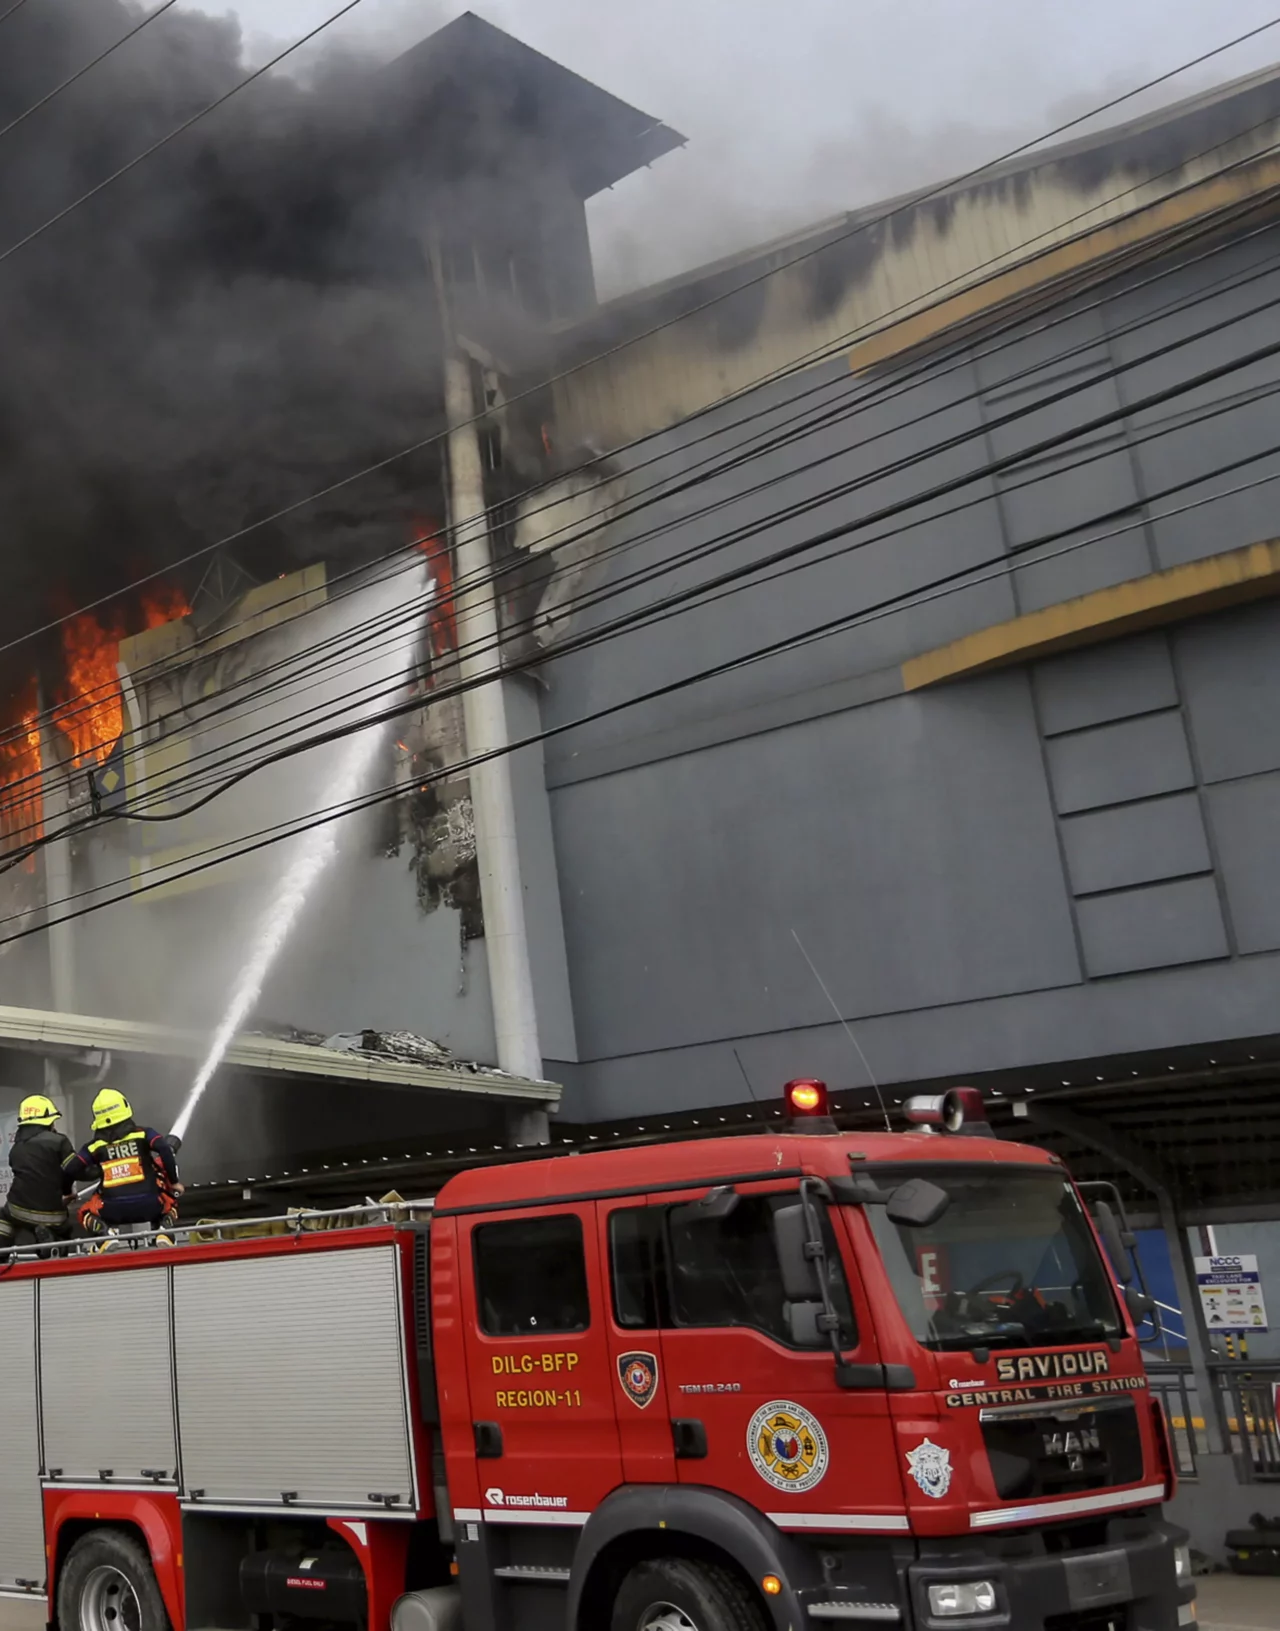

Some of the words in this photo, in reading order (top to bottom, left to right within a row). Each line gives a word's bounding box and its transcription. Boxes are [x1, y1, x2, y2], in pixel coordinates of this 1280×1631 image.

[107, 1142, 139, 1160] FIRE
[111, 1163, 130, 1175] BFP
[1209, 1257, 1241, 1265] NCCC
[921, 1253, 940, 1292] E
[492, 1353, 579, 1374] DILG-BFP
[997, 1351, 1109, 1380] SAVIOUR
[496, 1389, 581, 1407] REGION-11
[947, 1389, 1035, 1407] CENTRAL
[1048, 1383, 1083, 1398] FIRE
[1093, 1376, 1146, 1393] STATION
[1043, 1429, 1100, 1455] MAN
